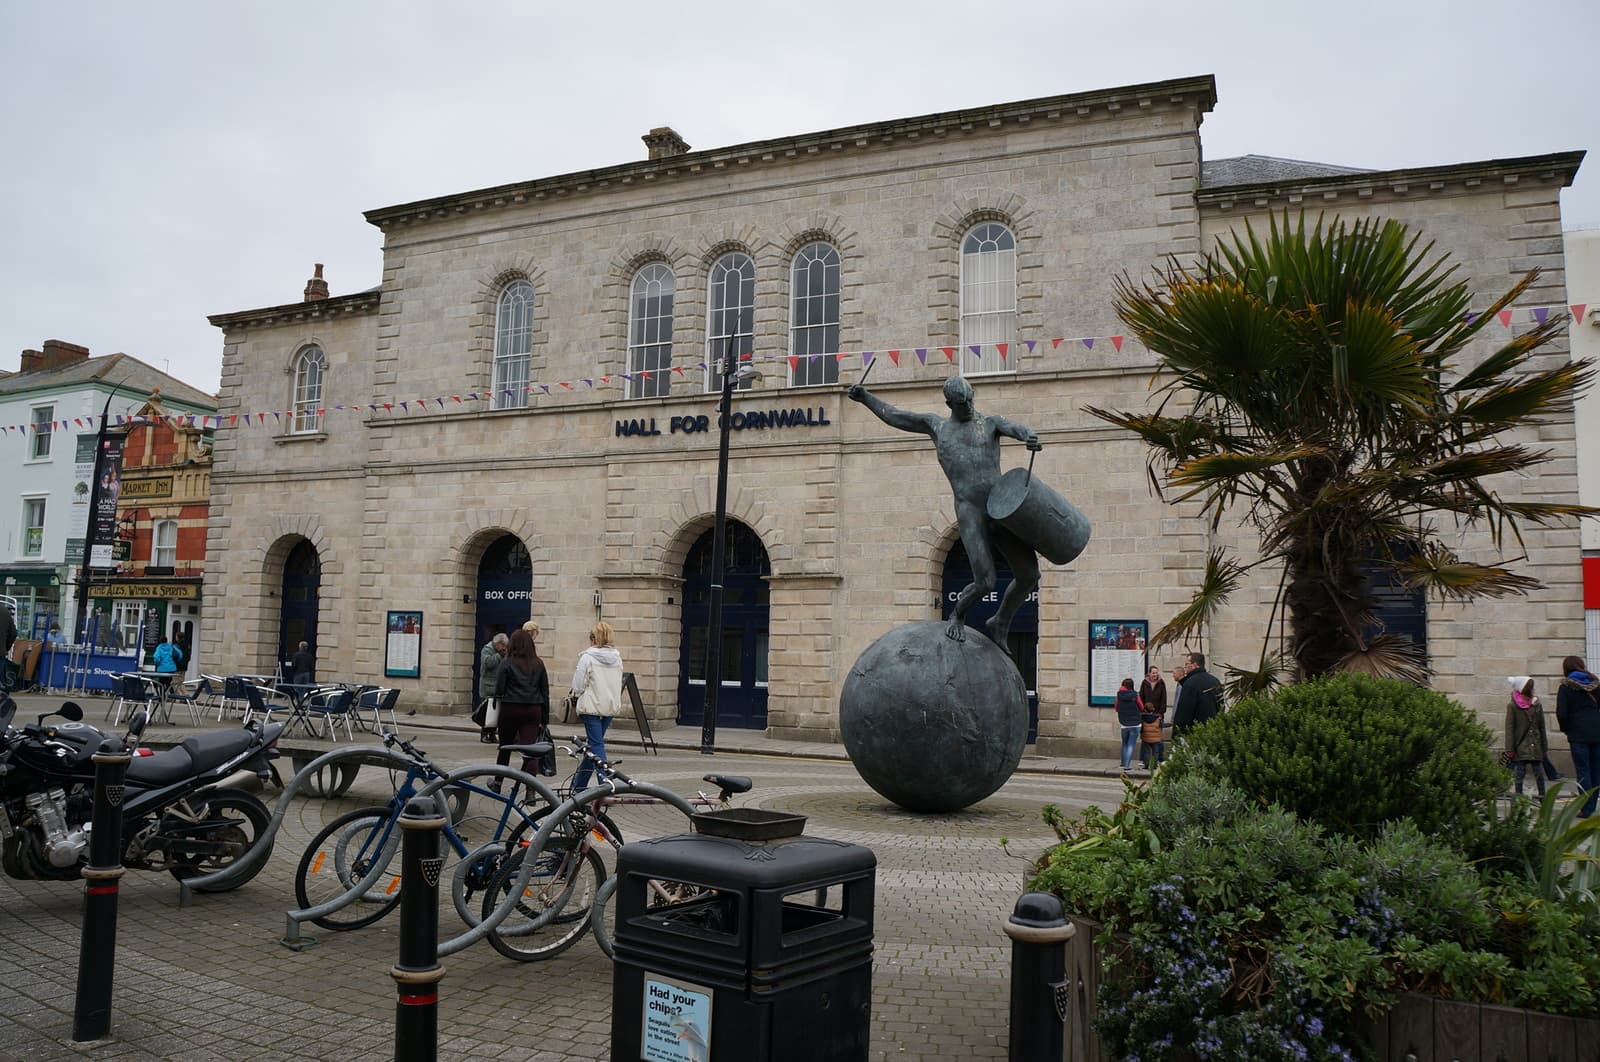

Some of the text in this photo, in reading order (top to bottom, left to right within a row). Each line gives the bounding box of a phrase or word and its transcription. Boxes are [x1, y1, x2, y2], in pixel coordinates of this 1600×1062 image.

[615, 418, 661, 437] HALL
[670, 415, 709, 434] FOR
[128, 585, 151, 596] WINES
[485, 590, 504, 600] BOX
[948, 591, 998, 602] COEE
[63, 665, 92, 674] Teate
[649, 985, 696, 1006] Had your
[649, 1000, 682, 1016] chips?
